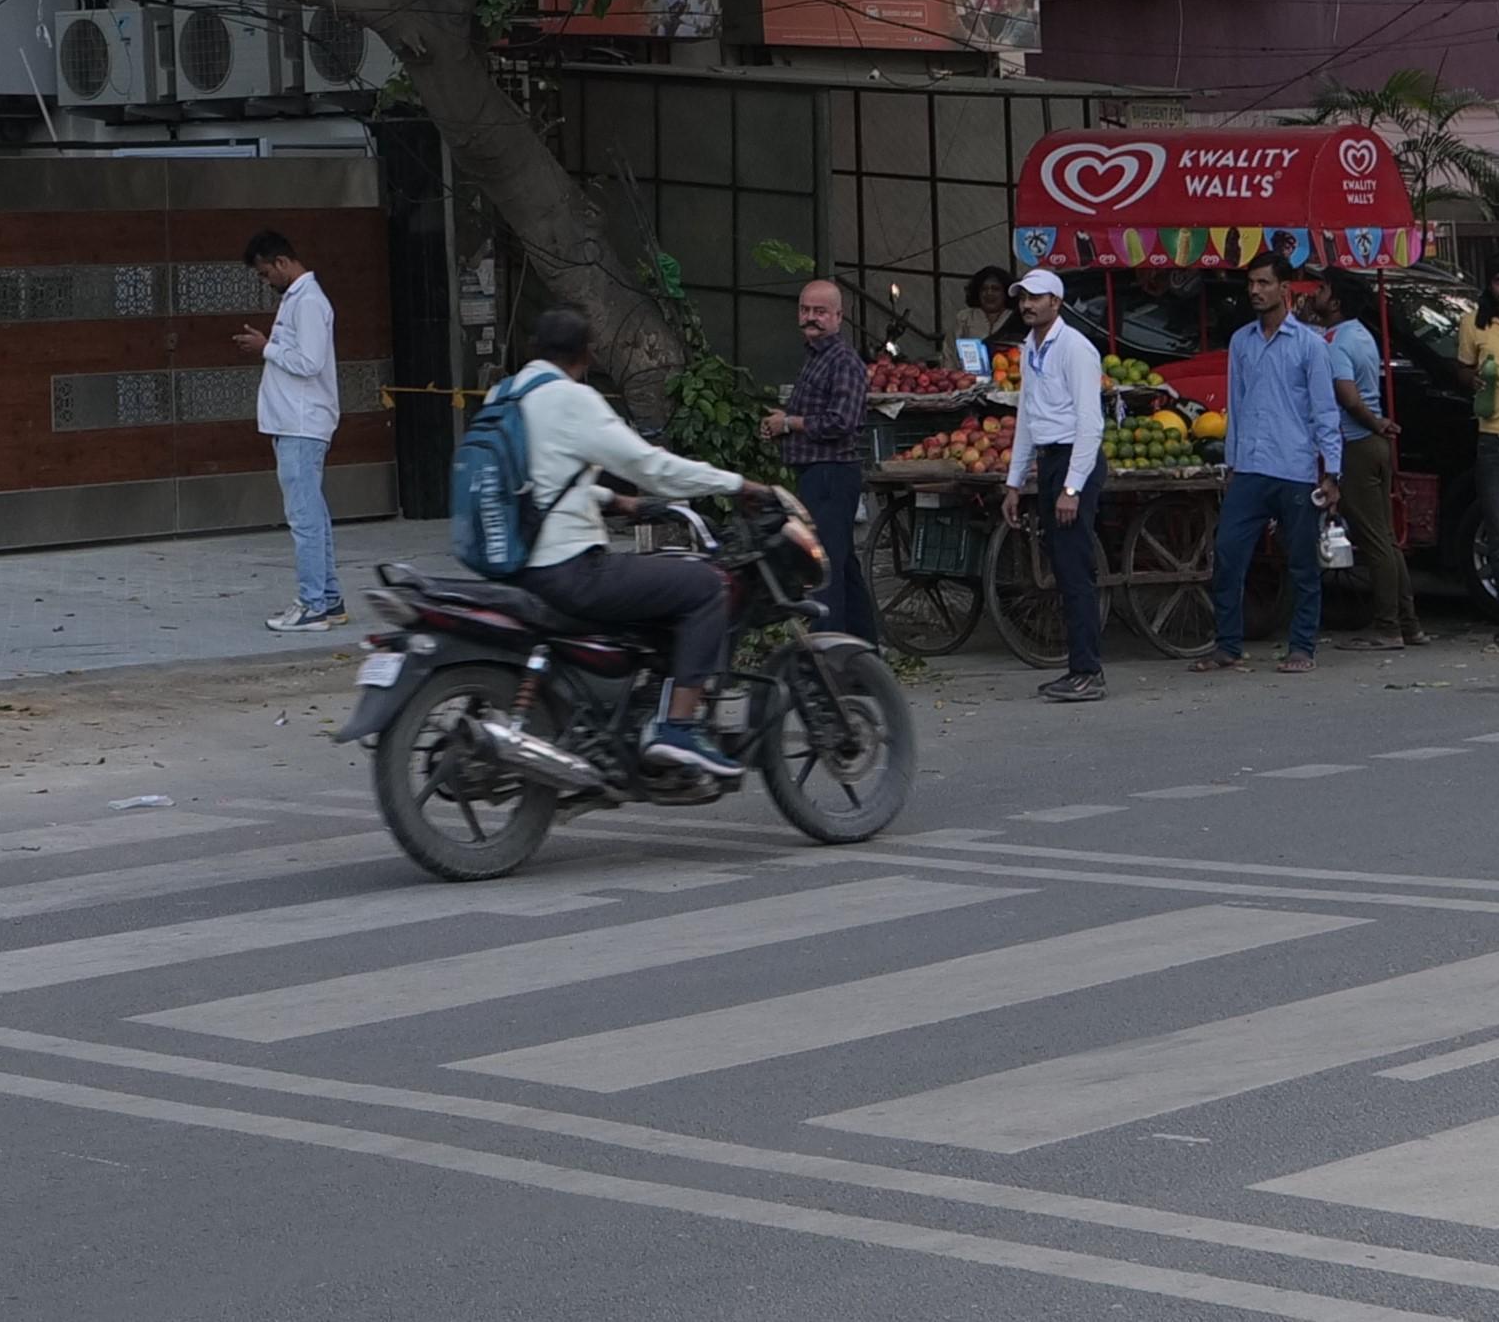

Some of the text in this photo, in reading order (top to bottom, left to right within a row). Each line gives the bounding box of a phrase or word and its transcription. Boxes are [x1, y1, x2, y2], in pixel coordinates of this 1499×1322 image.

[1178, 148, 1299, 168] KWALITY
[1185, 173, 1275, 199] WALL'S
[1342, 179, 1377, 192] KWALITY
[1346, 192, 1374, 205] WALL'S
